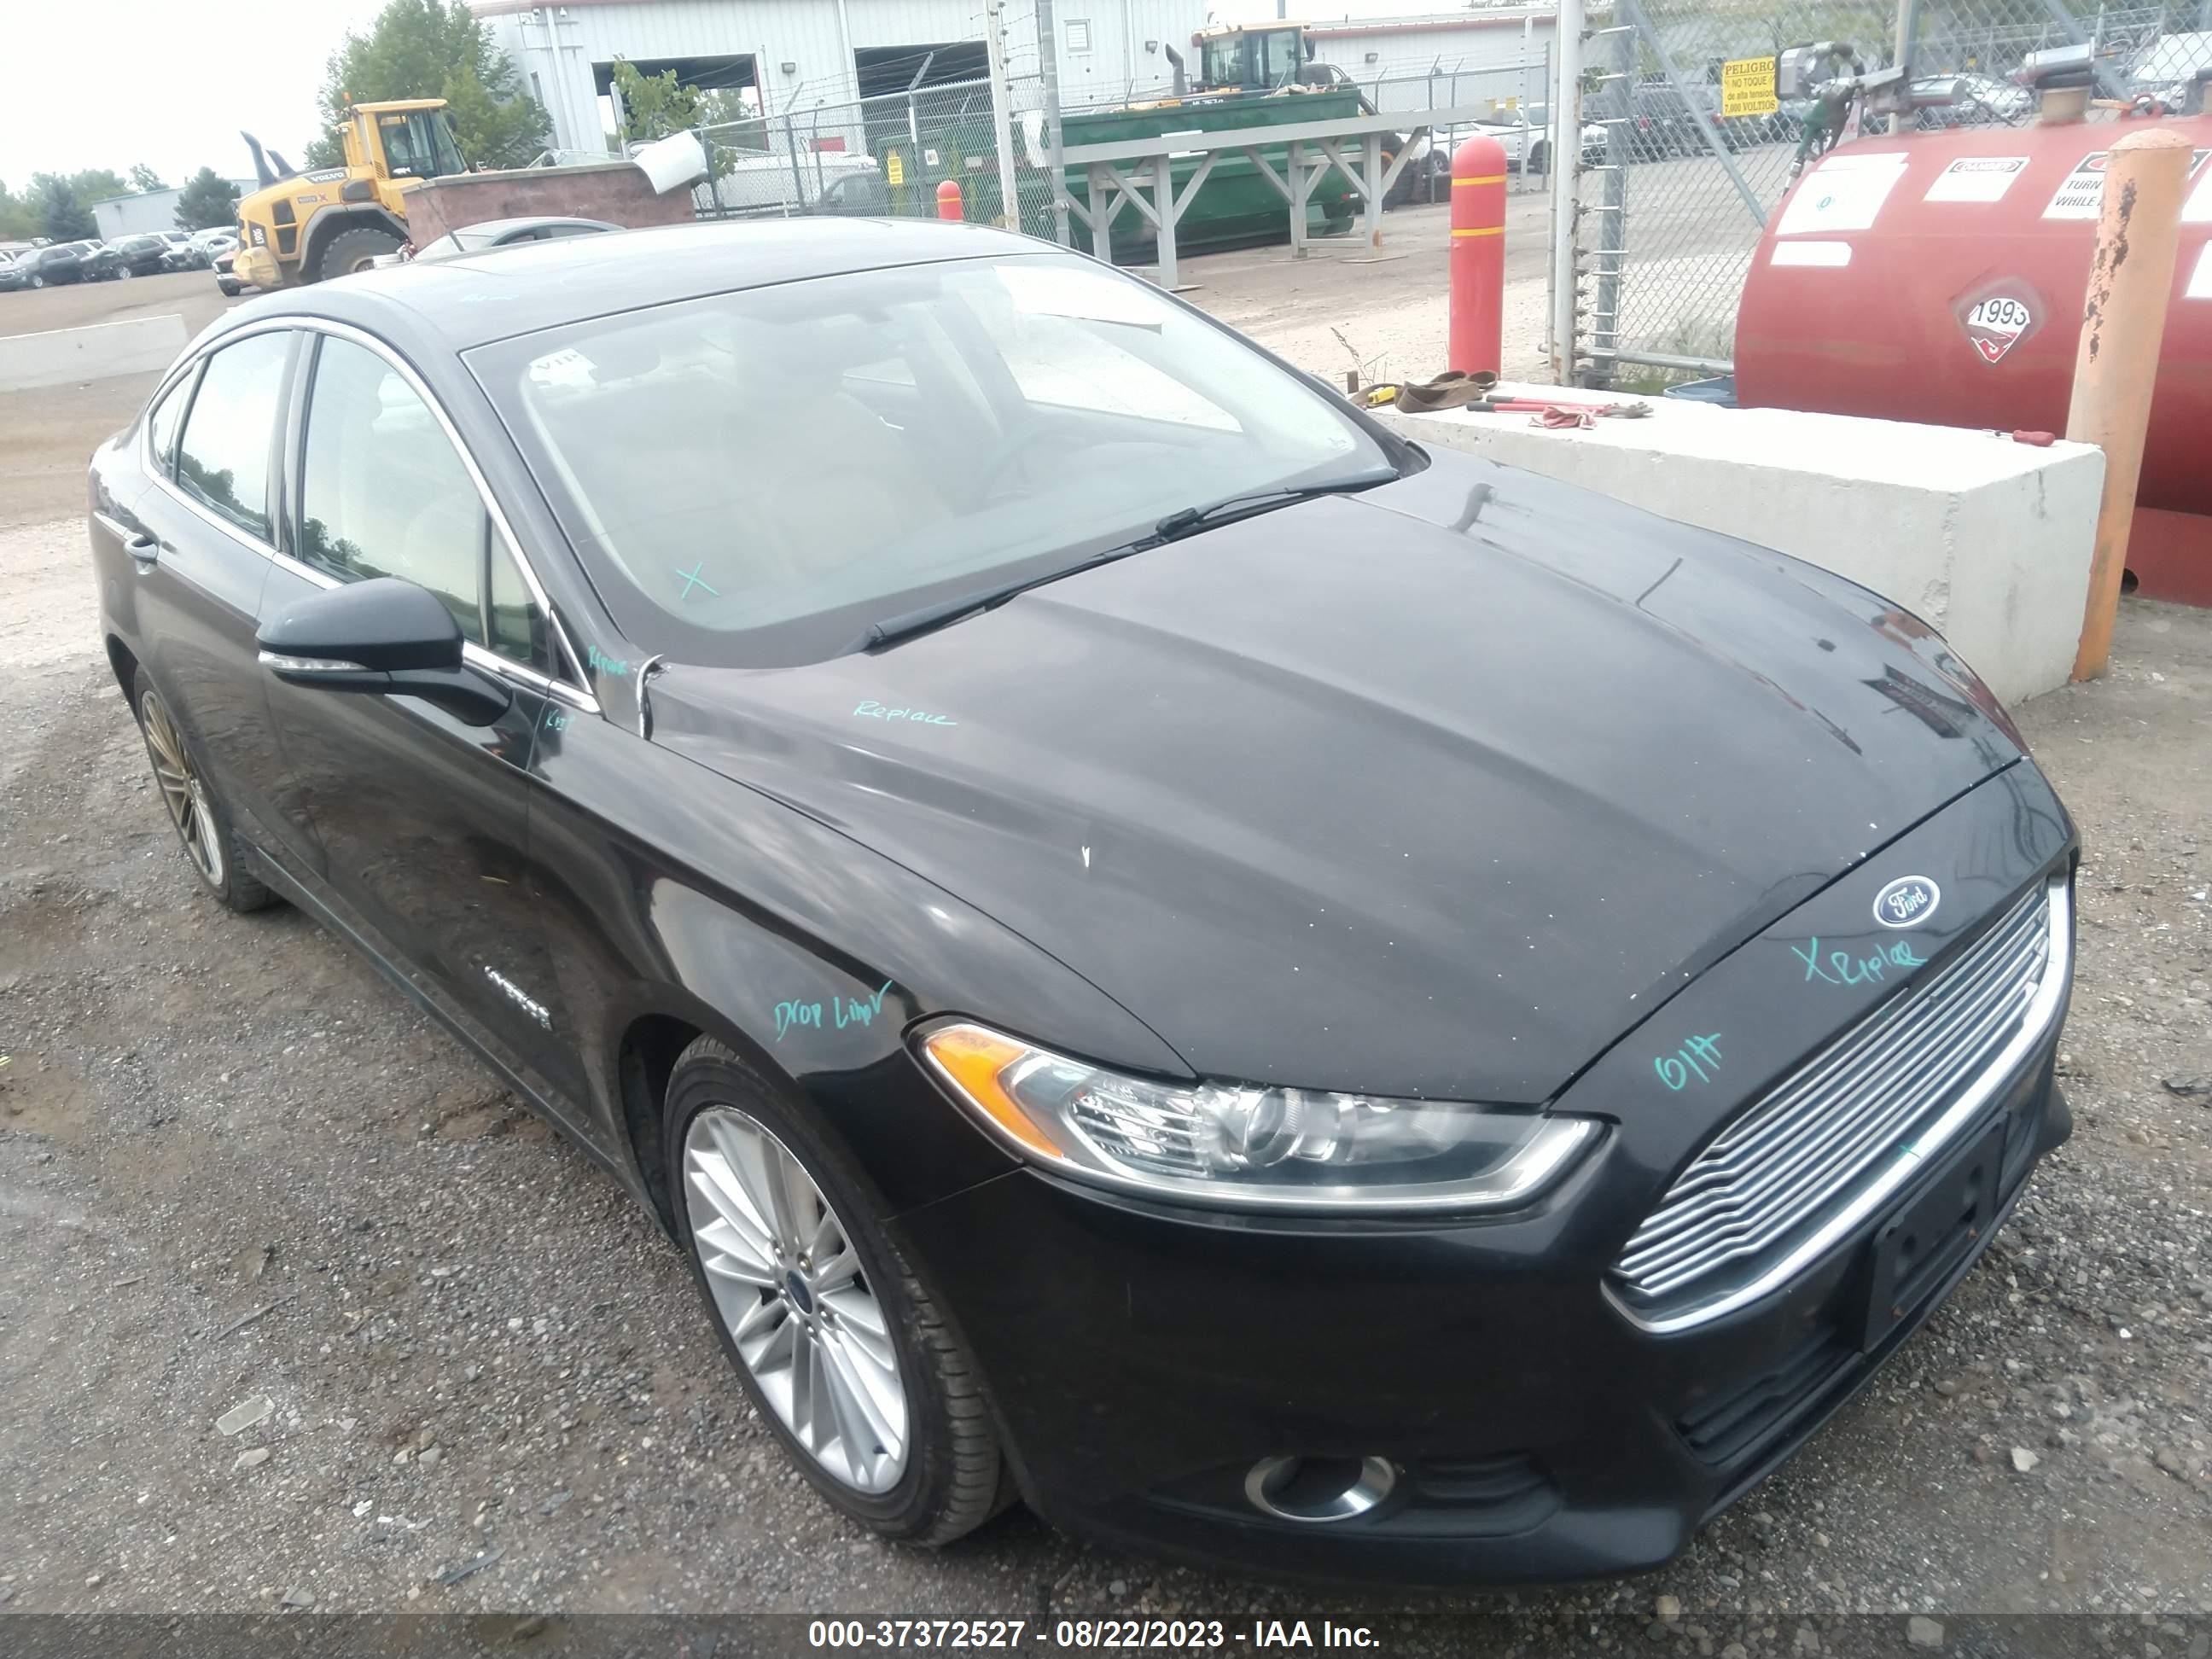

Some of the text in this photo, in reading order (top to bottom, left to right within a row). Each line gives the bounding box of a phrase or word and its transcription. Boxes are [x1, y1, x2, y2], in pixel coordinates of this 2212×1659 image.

[1726, 61, 1775, 75] PELIGRO
[1732, 76, 1767, 88] NO TOQUE
[1743, 100, 1775, 111] VOLTIOS
[310, 172, 345, 182] VOLVO
[2066, 180, 2103, 189] TURN
[2056, 196, 2097, 207] WHILE
[1888, 886, 1928, 918] Ford
[775, 998, 822, 1042] Drop
